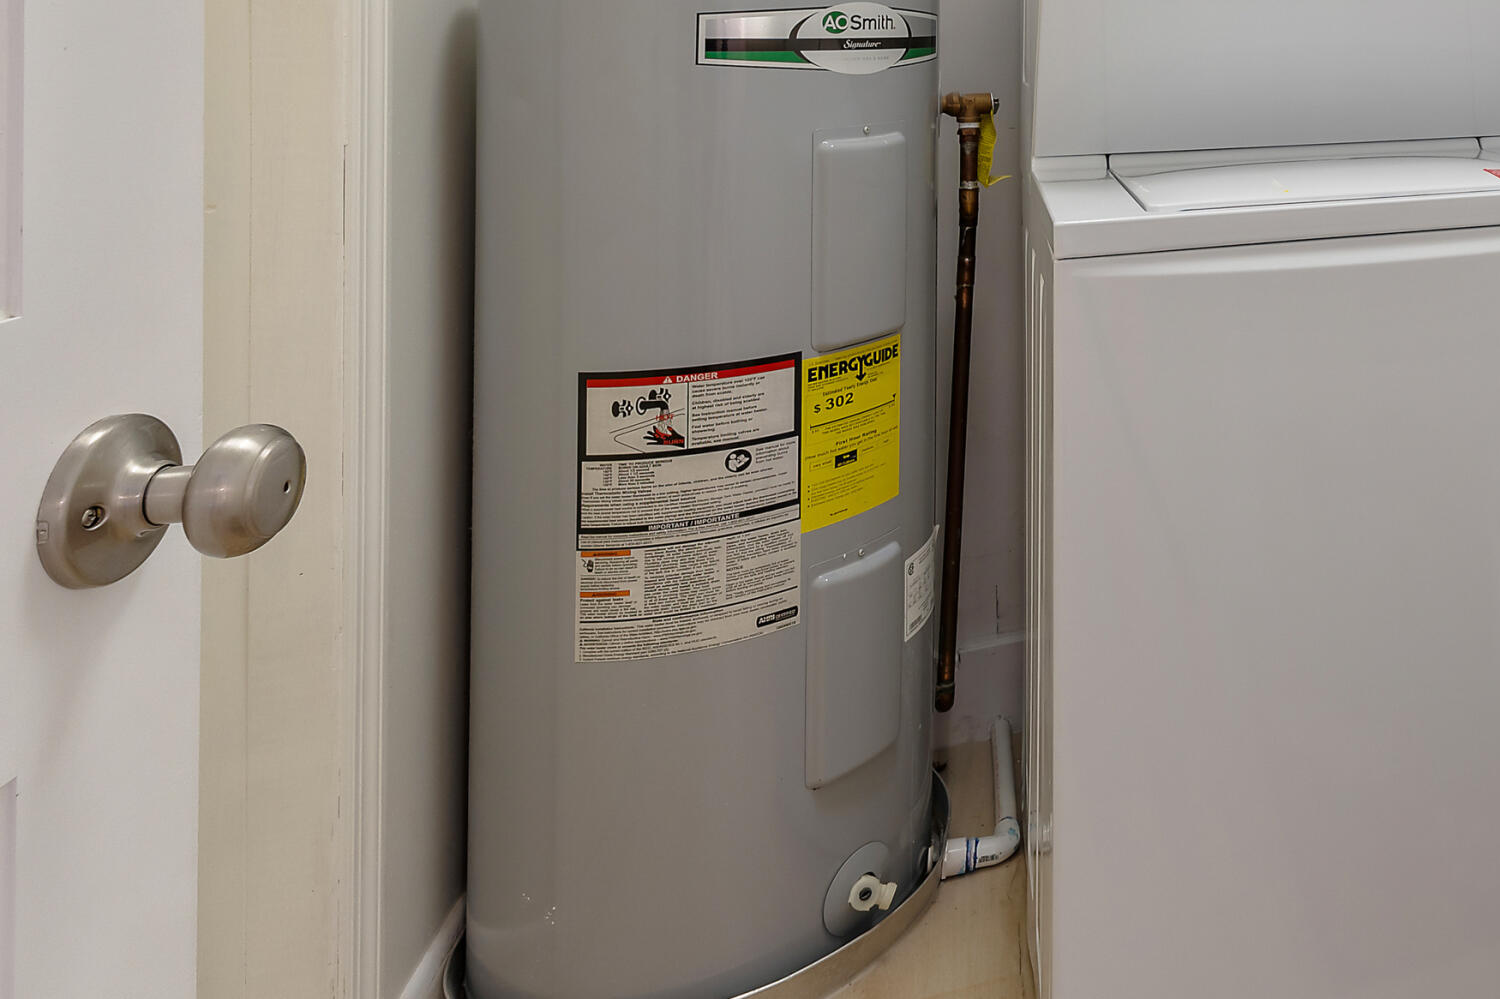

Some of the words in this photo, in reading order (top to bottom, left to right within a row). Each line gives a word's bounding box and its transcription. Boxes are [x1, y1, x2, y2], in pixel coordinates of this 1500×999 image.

[843, 39, 878, 50] Signature
[808, 343, 899, 383] ENERGYGUIDE
[676, 372, 718, 383] DANGER
[814, 404, 821, 414] $
[825, 392, 854, 410] 302
[648, 520, 689, 531] IMPORTANT
[694, 512, 740, 525] IMPORTANTE
